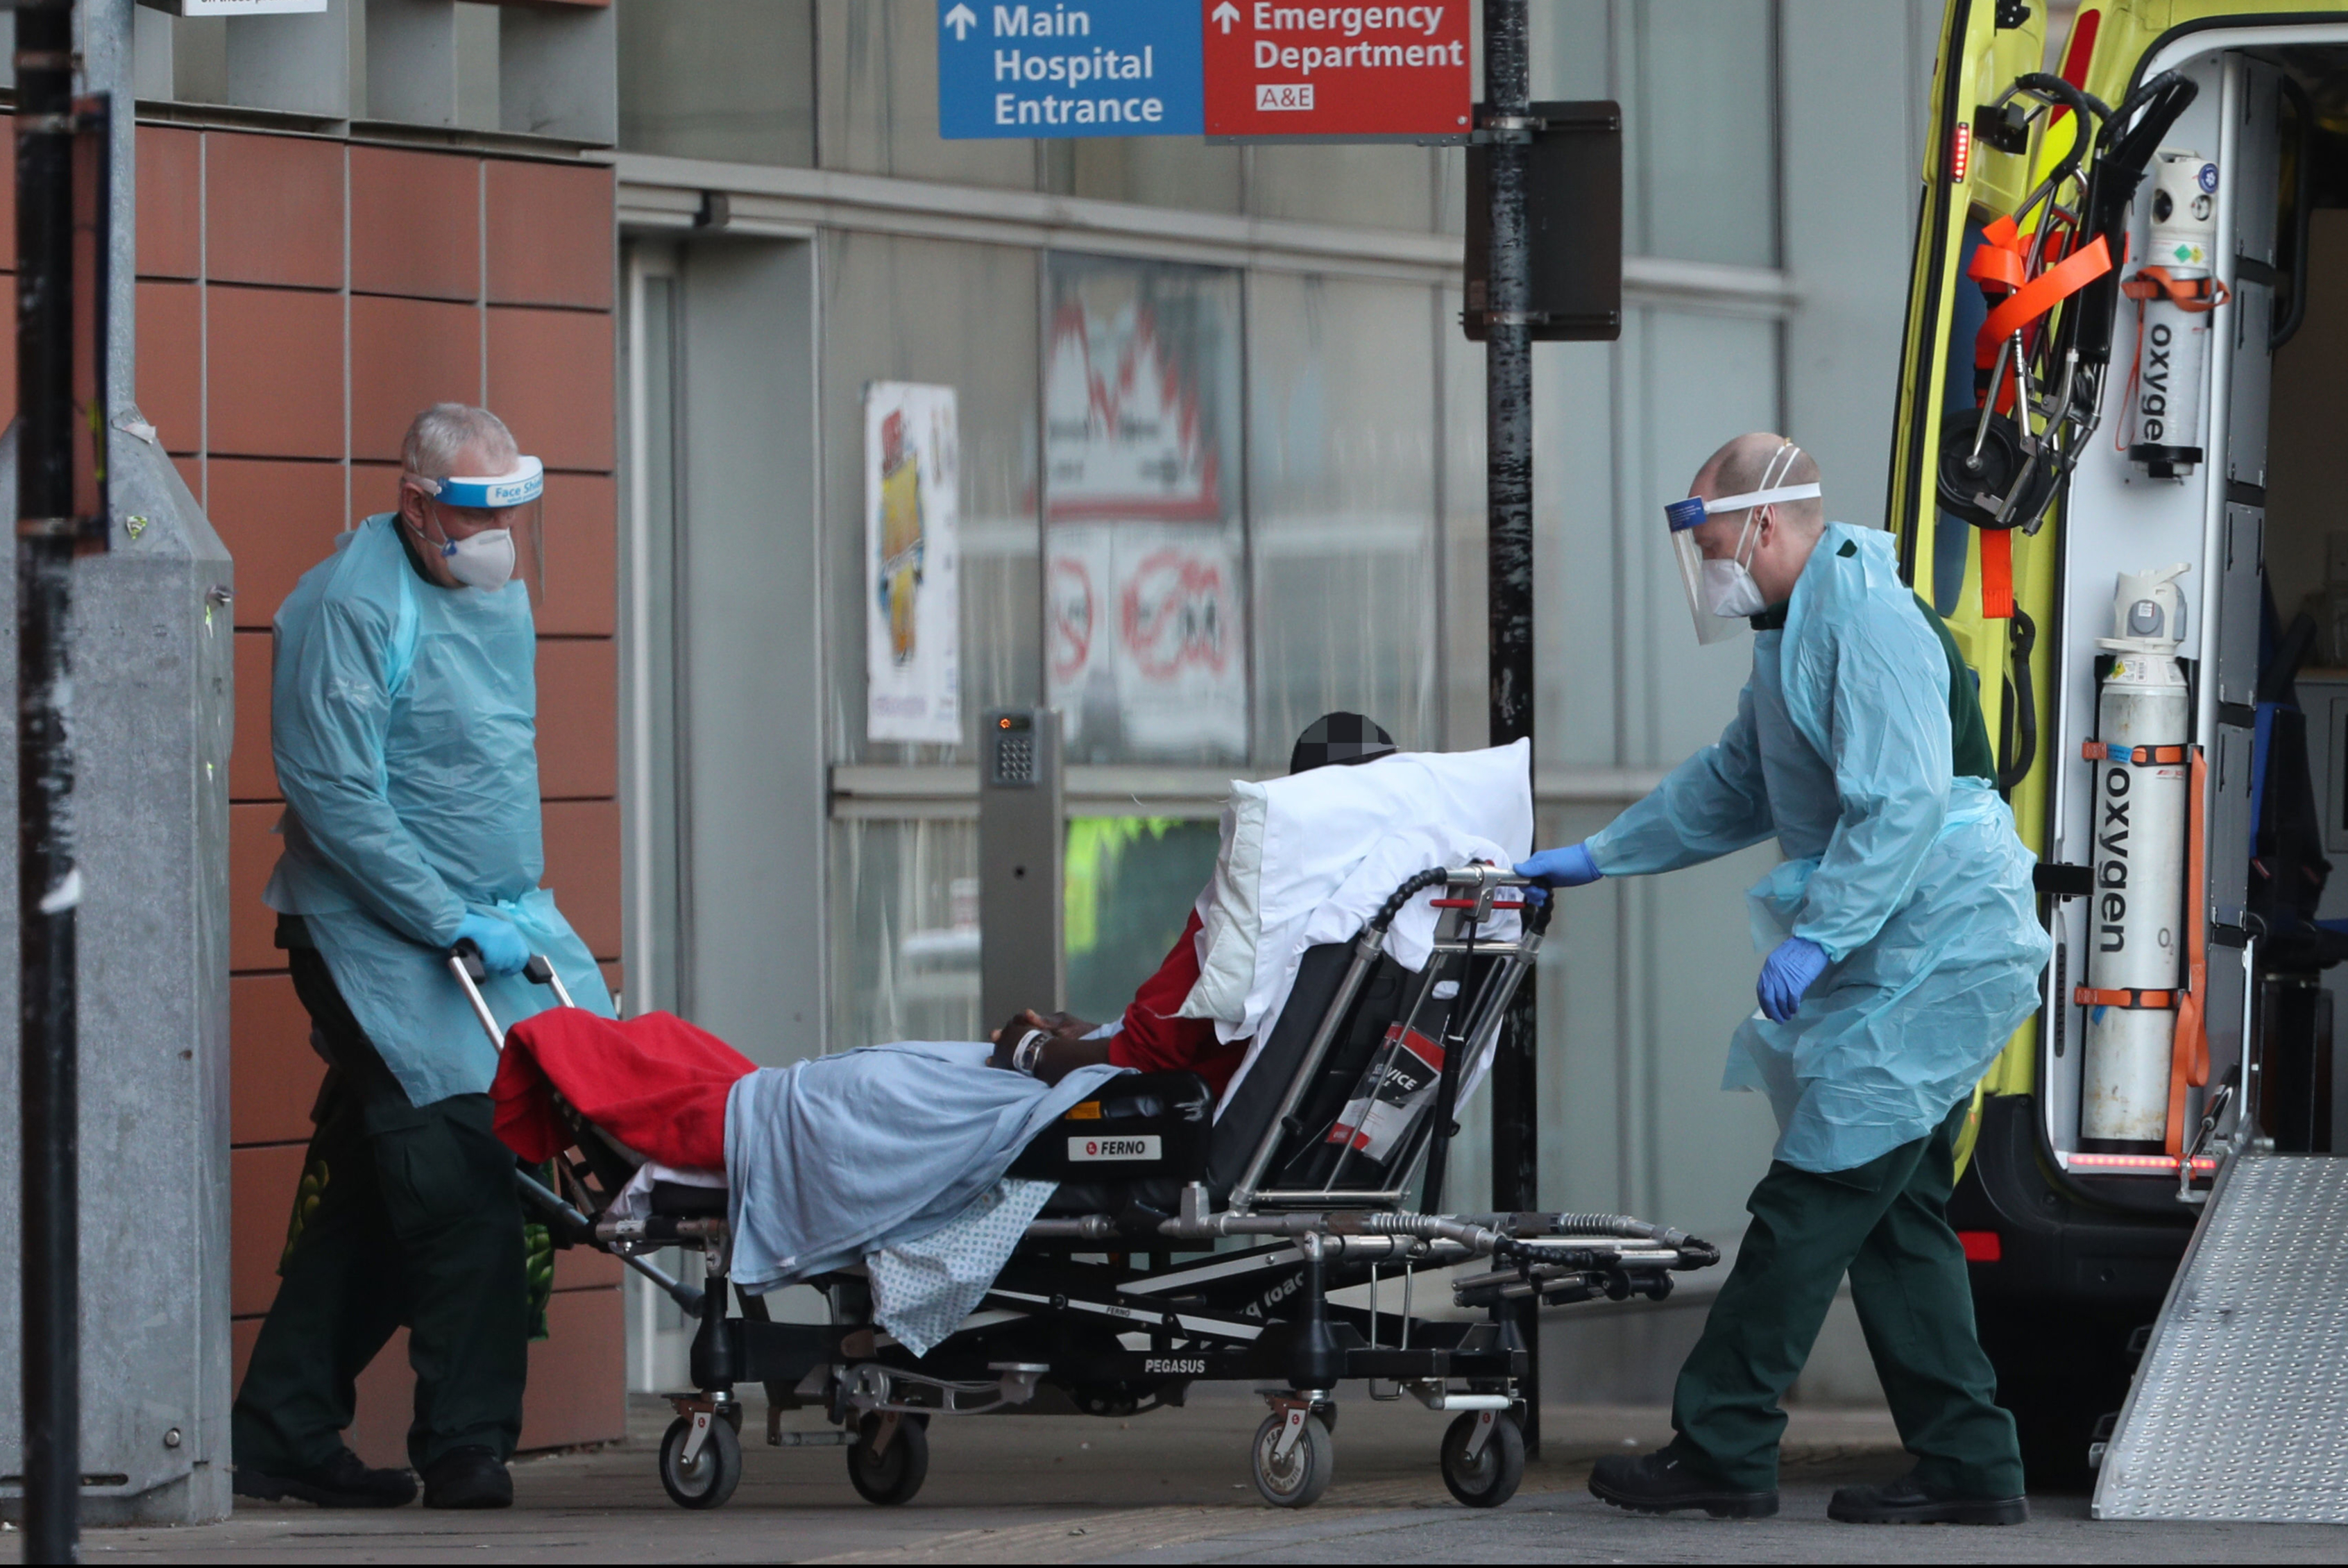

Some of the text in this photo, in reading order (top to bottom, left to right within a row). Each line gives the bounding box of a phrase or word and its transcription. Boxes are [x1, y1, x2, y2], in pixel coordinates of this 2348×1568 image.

[994, 3, 1090, 37] Main
[1254, 1, 1444, 36] Emergency
[994, 45, 1152, 89] Hospital
[1254, 40, 1464, 76] Department
[995, 93, 1164, 125] Entrance
[1261, 87, 1311, 108] A&E
[2141, 323, 2172, 445] oxyge
[495, 487, 521, 498] Face
[2098, 767, 2130, 953] oxygen
[1101, 1141, 1146, 1155] FERNO
[1106, 1306, 1130, 1318] FERNO
[1145, 1359, 1205, 1374] PEGASUS
